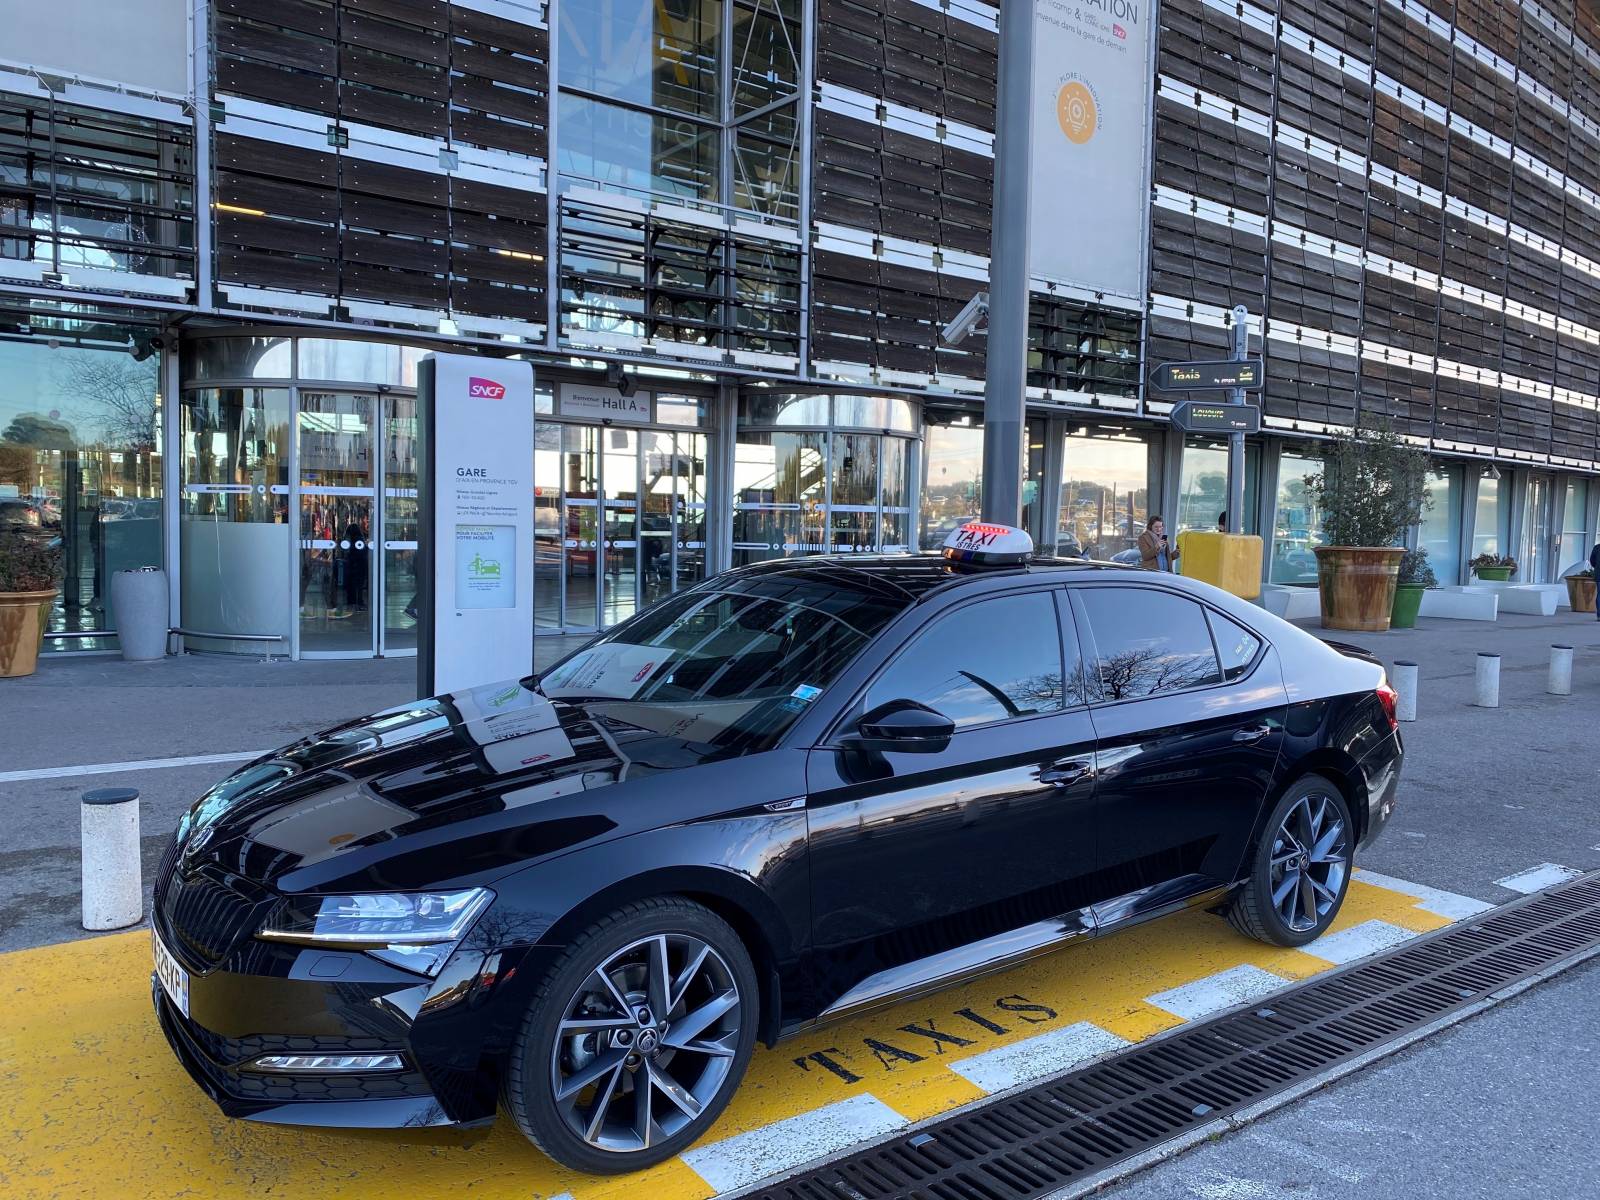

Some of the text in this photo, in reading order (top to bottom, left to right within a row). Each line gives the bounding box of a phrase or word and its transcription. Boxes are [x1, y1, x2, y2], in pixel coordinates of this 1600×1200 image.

[1074, 8, 1081, 21] &
[1081, 0, 1138, 25] TION
[1171, 369, 1201, 380] Taxis
[470, 385, 504, 397] SNCF
[602, 398, 626, 410] Hall
[628, 400, 637, 411] A
[456, 467, 487, 477] GARE
[956, 530, 998, 546] TAXI
[956, 541, 980, 551] ISTRES
[792, 994, 1058, 1084] TAXIS
